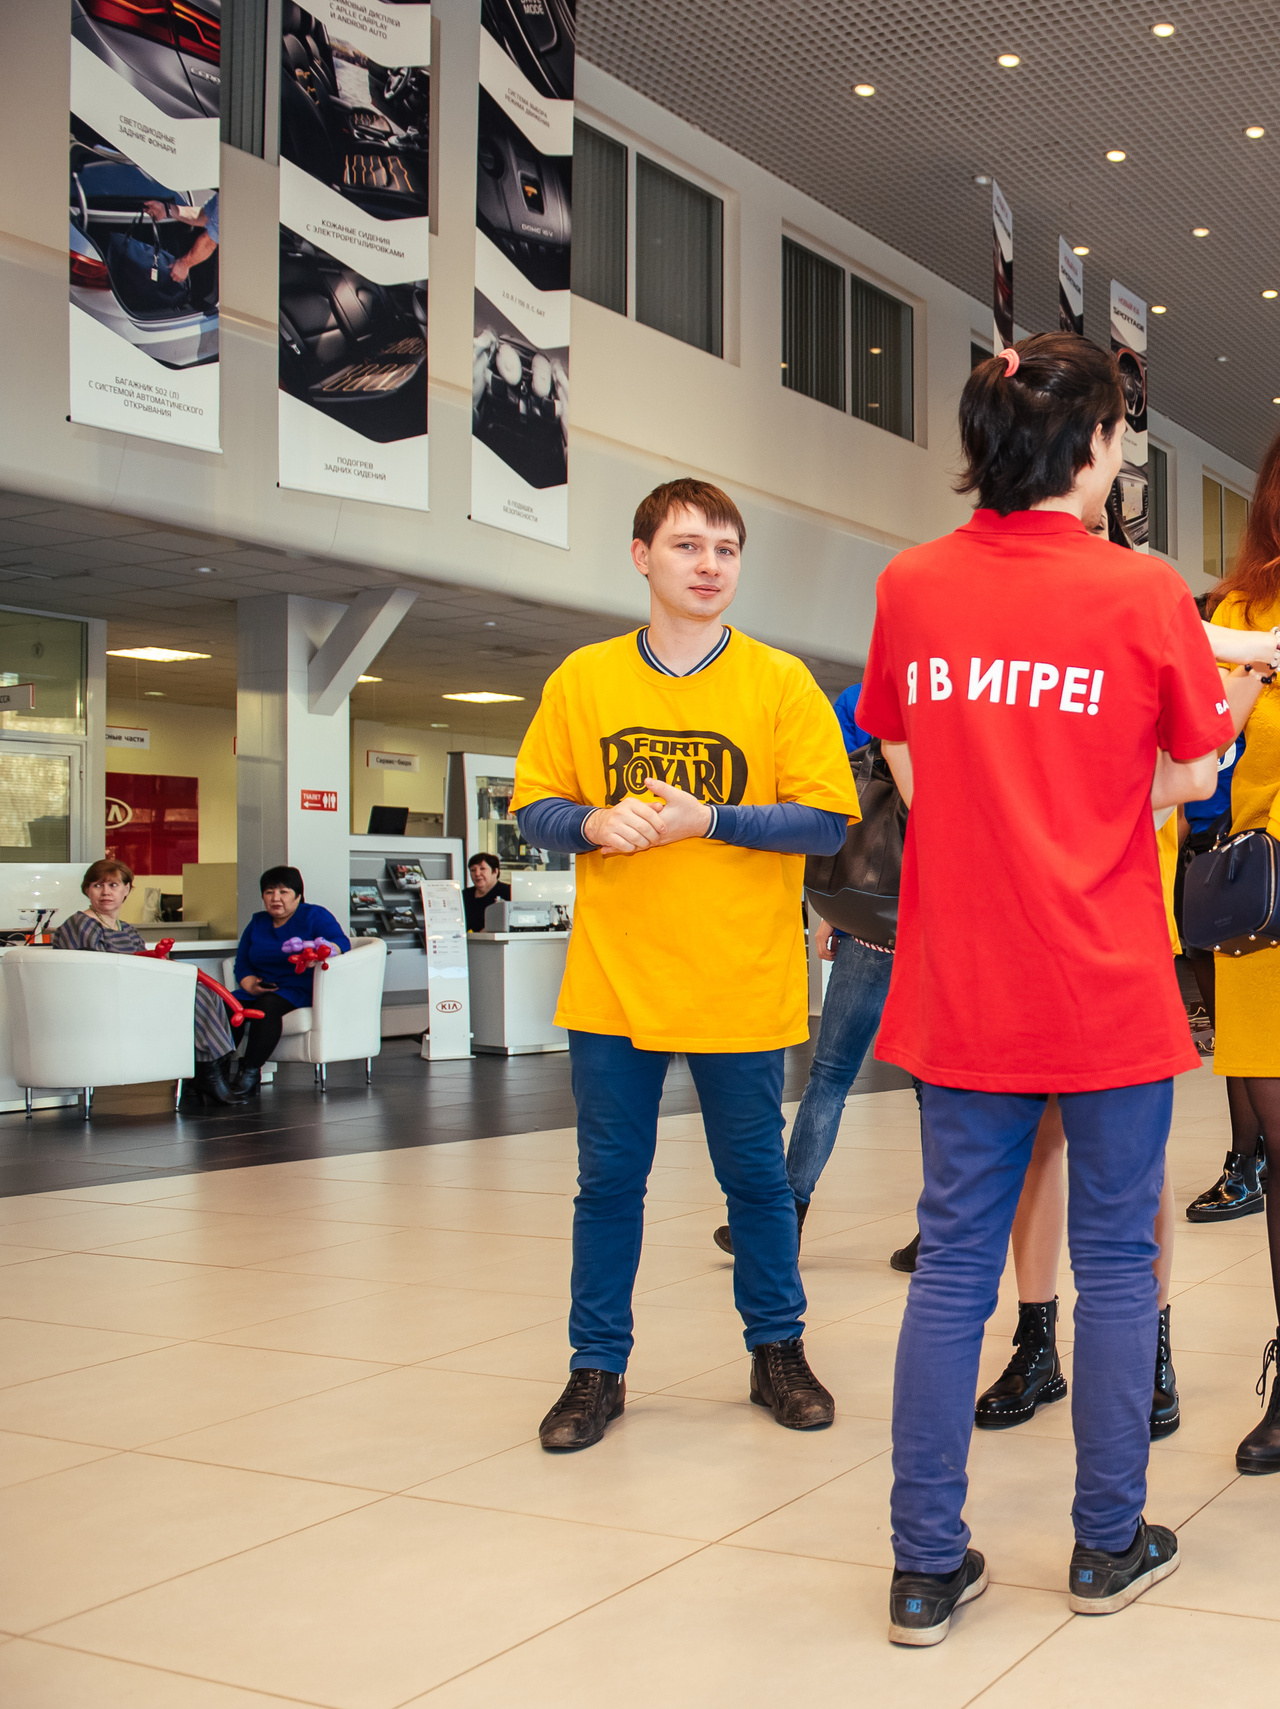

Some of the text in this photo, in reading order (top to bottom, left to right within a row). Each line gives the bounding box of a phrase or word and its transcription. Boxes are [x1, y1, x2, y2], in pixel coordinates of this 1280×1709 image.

[329, 2, 388, 30] С APLLE CARPLAY
[337, 15, 367, 31] ANDROID
[369, 27, 387, 39] AUTO
[369, 9, 400, 27] ДИСПЛЕЙ
[119, 115, 175, 144] СВЕТОДИОДНЫЕ
[119, 125, 176, 154] ЗАДНИЕ ФОНАРИ
[313, 226, 405, 258] ЭЛЕКТРОРЕГУЛИРОВКАМИ
[321, 219, 390, 246] КОЖАНЫЕ СИДЕНИЯ
[1113, 306, 1145, 332] SPORTAGE
[88, 380, 204, 416] С СИСТЕМОЙ АВТОМАТИЧЕСКОГО
[115, 376, 180, 400] БАГАЖНИК 502 (Л)
[124, 399, 172, 417] ОТКРЫВАНИЯ
[324, 463, 386, 481] ЗАДНИХ СИДЕНИЙ
[337, 456, 374, 470] ПОДОГРЕВ
[907, 657, 1105, 716] Я В ИГРЕ!
[124, 735, 145, 743] части
[624, 738, 704, 757] FORT
[600, 736, 748, 806] BOYARD
